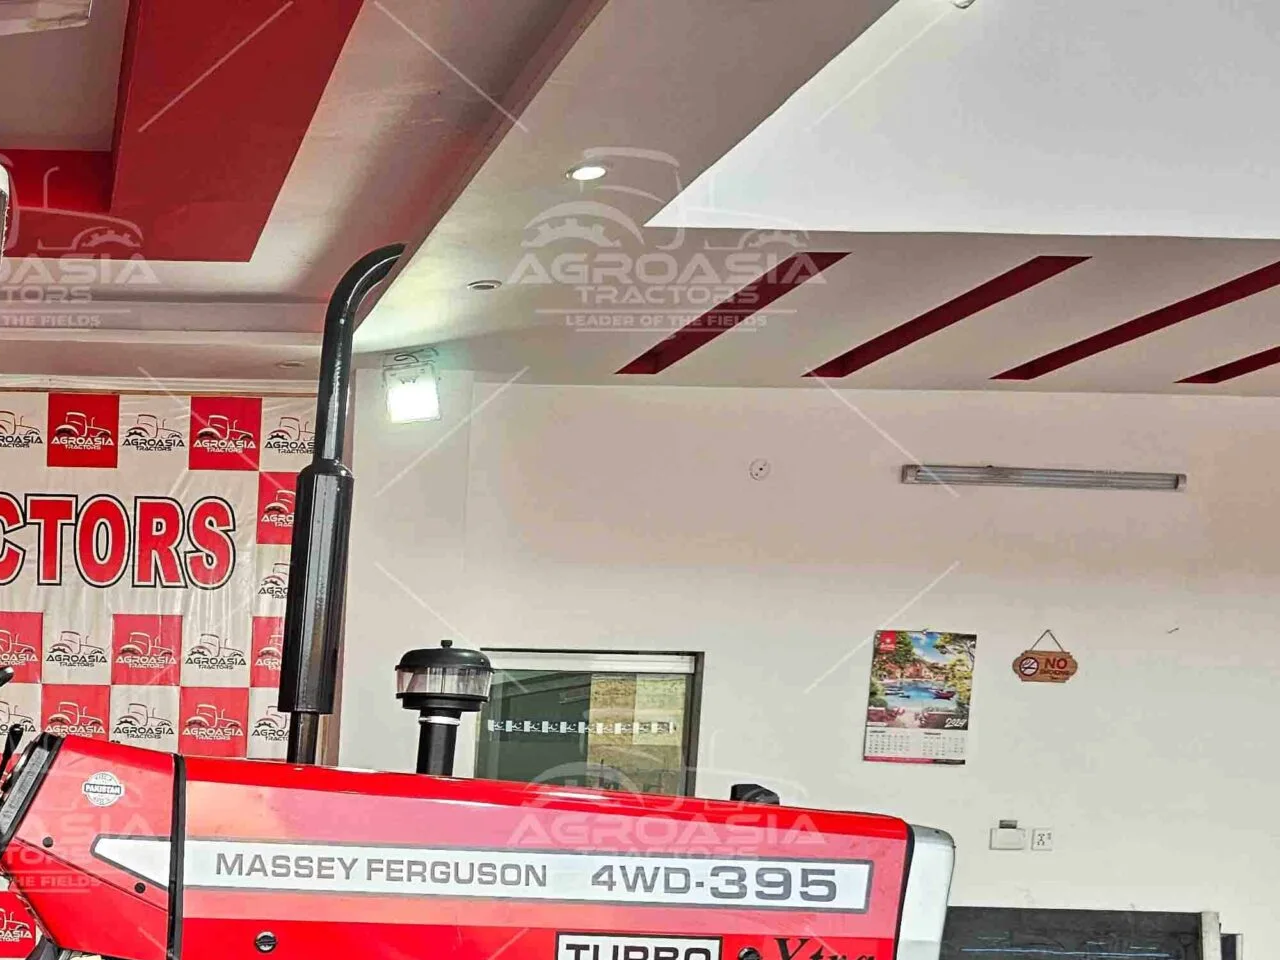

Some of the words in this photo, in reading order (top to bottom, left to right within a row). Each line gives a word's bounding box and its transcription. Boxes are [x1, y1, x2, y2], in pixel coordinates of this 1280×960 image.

[50, 436, 114, 446] AGROASIA
[122, 438, 185, 447] AGROASIA
[193, 439, 256, 449] AGROASIA
[265, 440, 315, 450] AGROAS
[45, 654, 107, 663] AGROASIA
[115, 656, 177, 665] AGROASIA
[184, 657, 246, 666] AGROASIA
[1044, 657, 1068, 670] NO
[113, 727, 174, 735] AGROASIA
[182, 728, 243, 737] AGROASIA
[215, 852, 357, 881] MASSEY
[366, 859, 548, 888] FERGUSON
